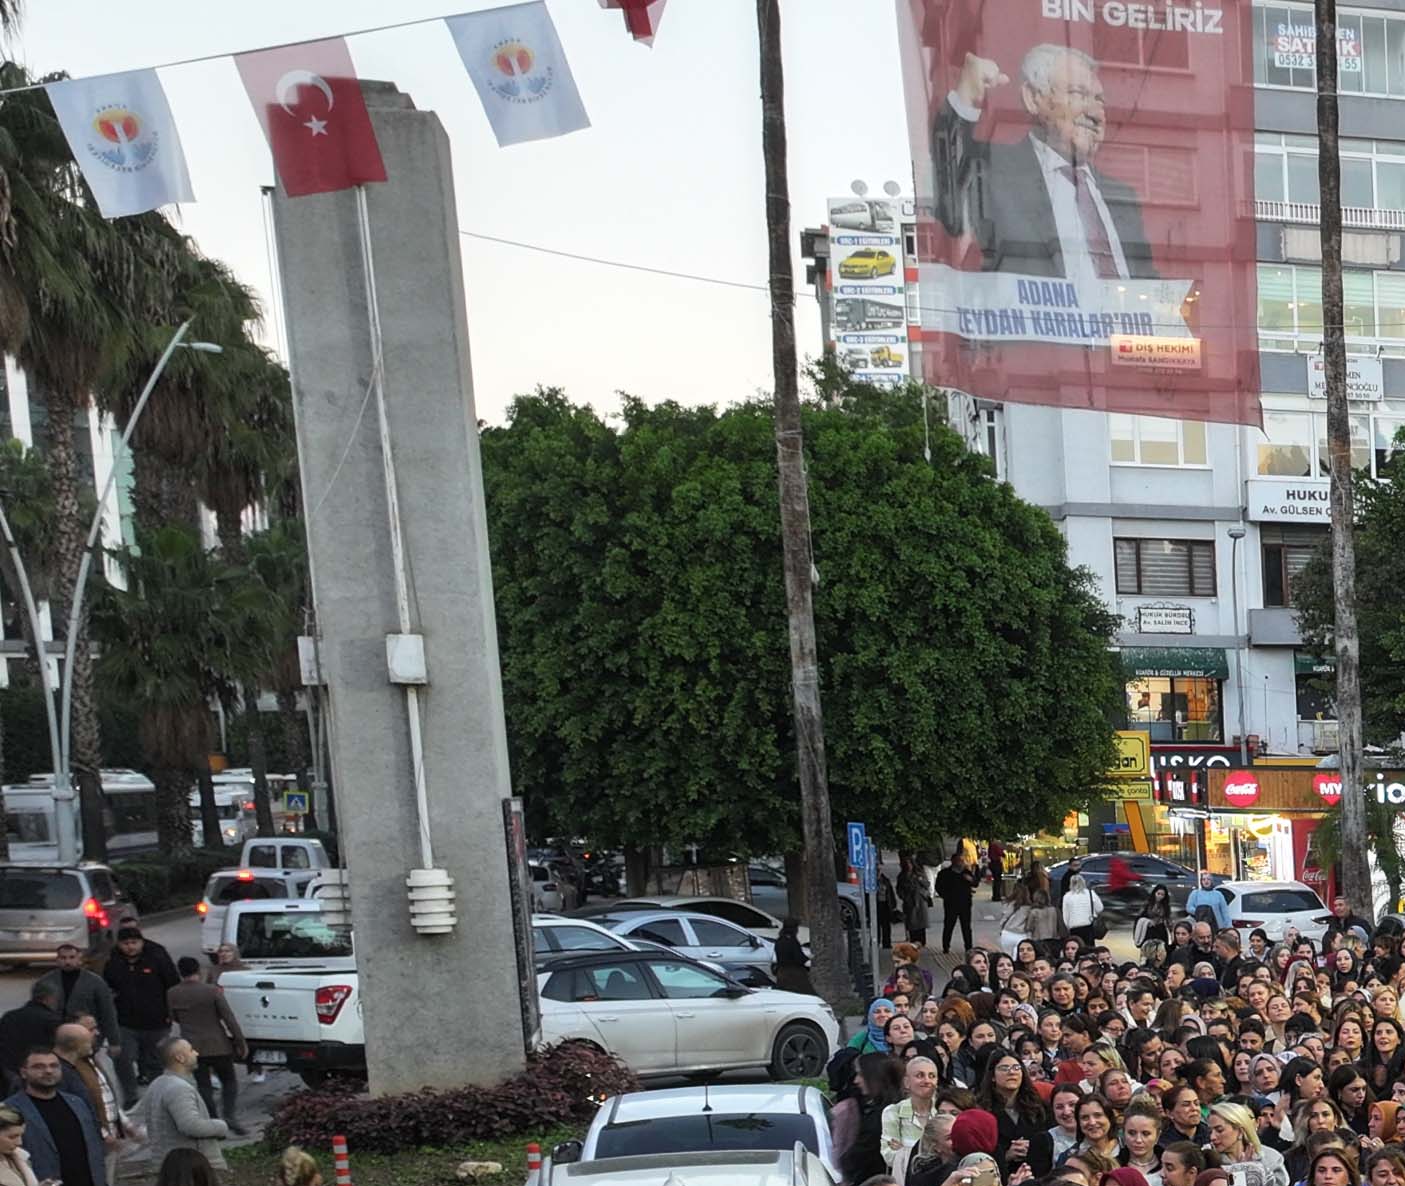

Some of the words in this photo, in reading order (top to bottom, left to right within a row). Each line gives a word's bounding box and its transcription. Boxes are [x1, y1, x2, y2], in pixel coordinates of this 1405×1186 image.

[1102, 0, 1224, 34] GELİRİZ
[1017, 279, 1080, 309] ADANA
[1032, 309, 1154, 338] KARALAR'DIR
[1286, 489, 1328, 501] HUKU
